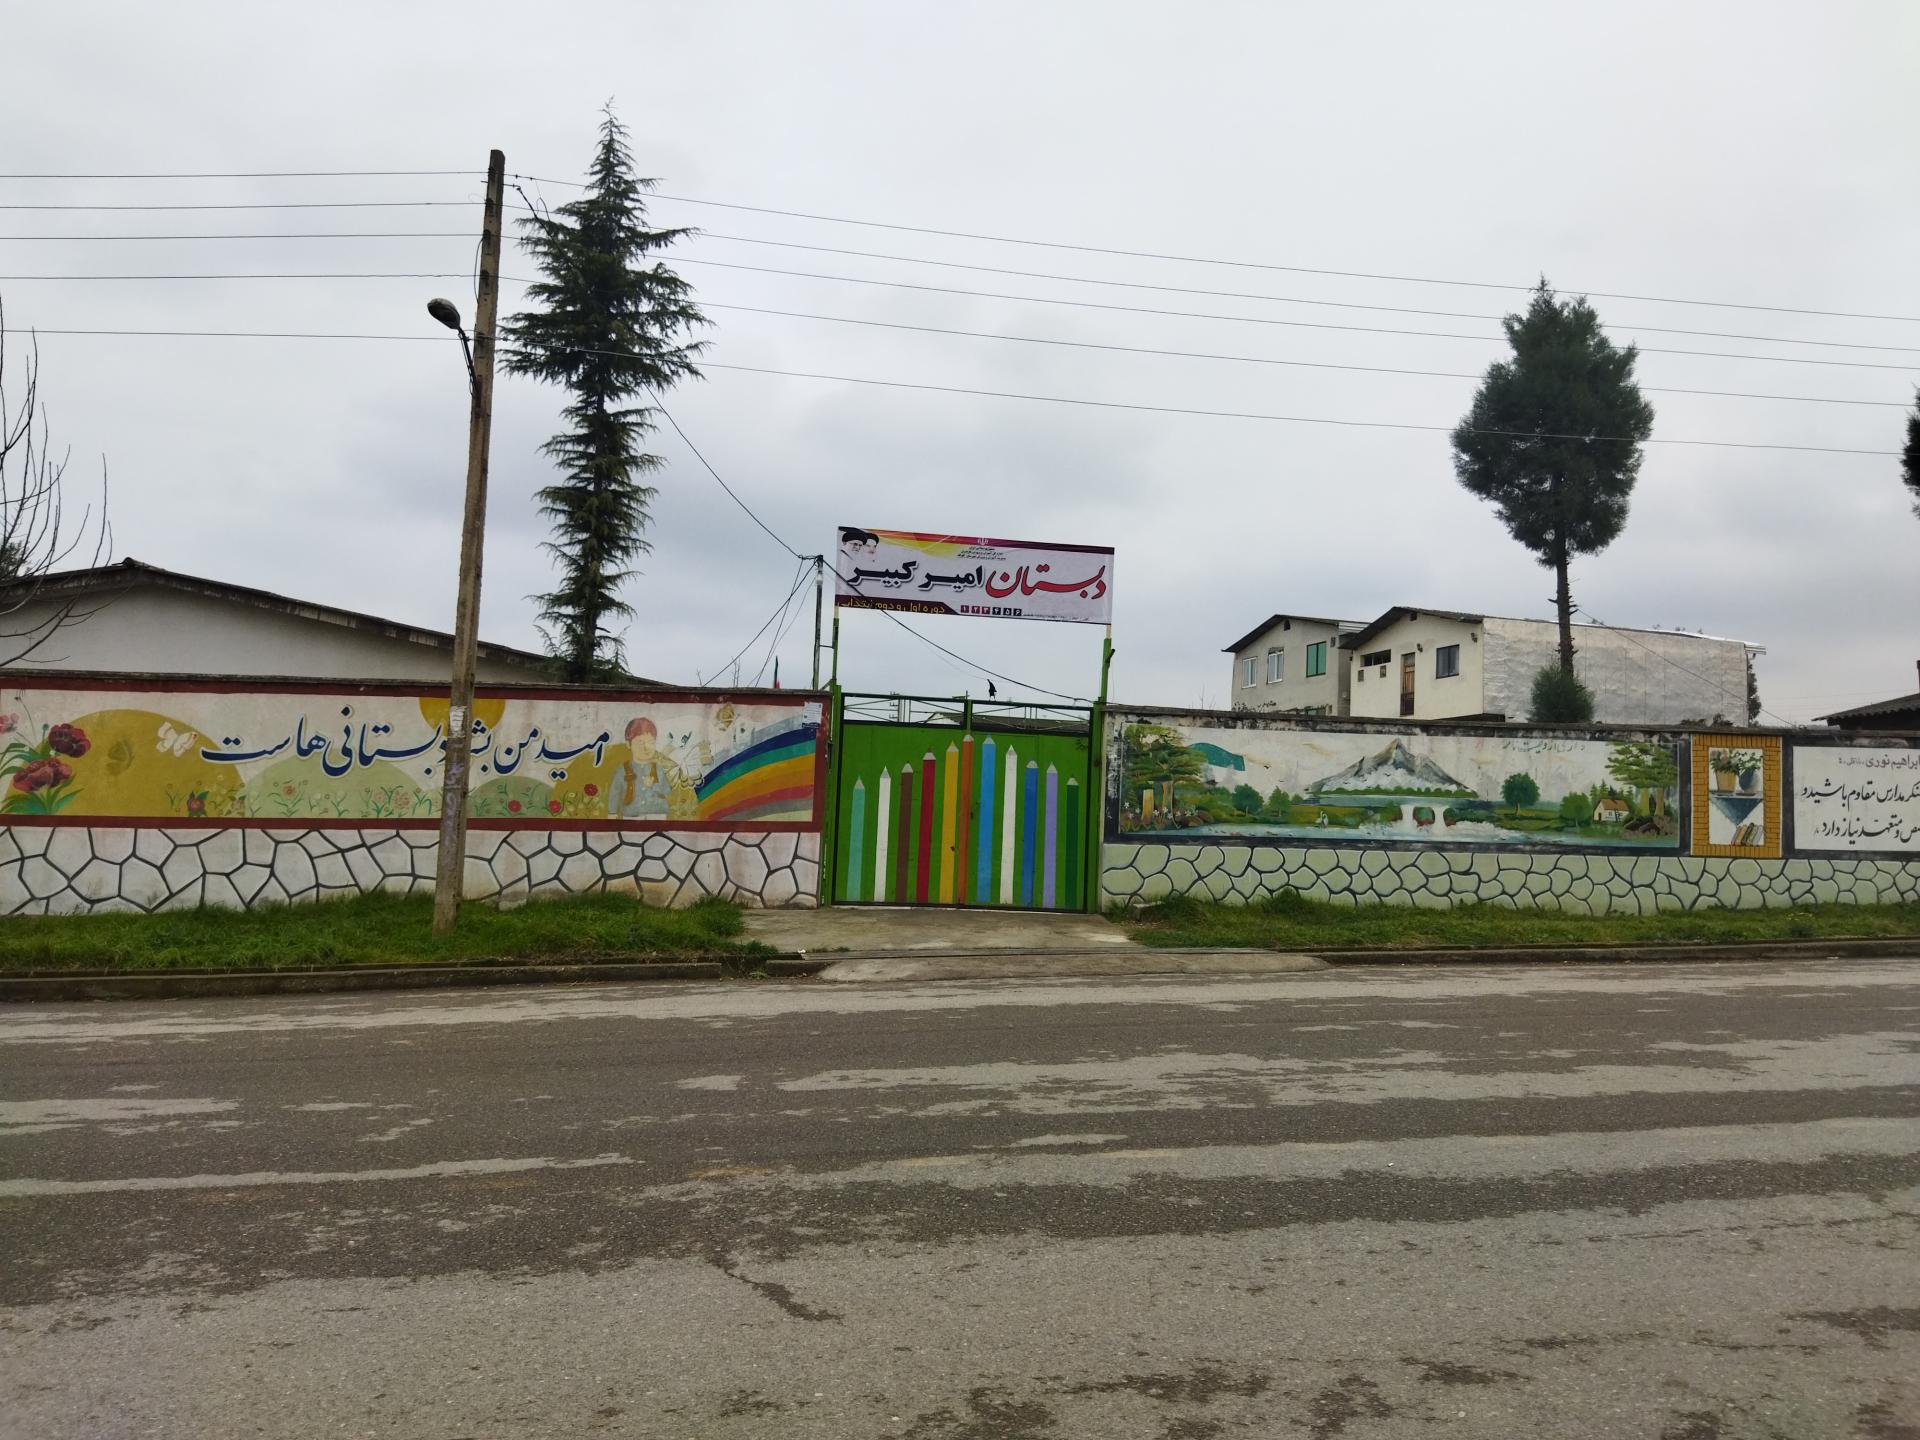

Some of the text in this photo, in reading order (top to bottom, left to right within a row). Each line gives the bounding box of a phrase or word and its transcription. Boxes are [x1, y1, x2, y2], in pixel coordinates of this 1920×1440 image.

[847, 560, 1107, 600] دبستان امیر کبیر
[875, 601, 895, 610] دوم
[923, 605, 945, 614] دوره
[494, 727, 539, 775] من
[534, 730, 611, 780] امید
[1866, 754, 1890, 768] نوری
[1806, 778, 1847, 807] باشید
[1847, 780, 1876, 812] مقاوم
[1877, 784, 1905, 803] مدارس
[1822, 819, 1840, 836] دارد
[1841, 817, 1860, 845] نیاز
[1858, 814, 1903, 837] متعهد
[1894, 829, 1900, 838] و
